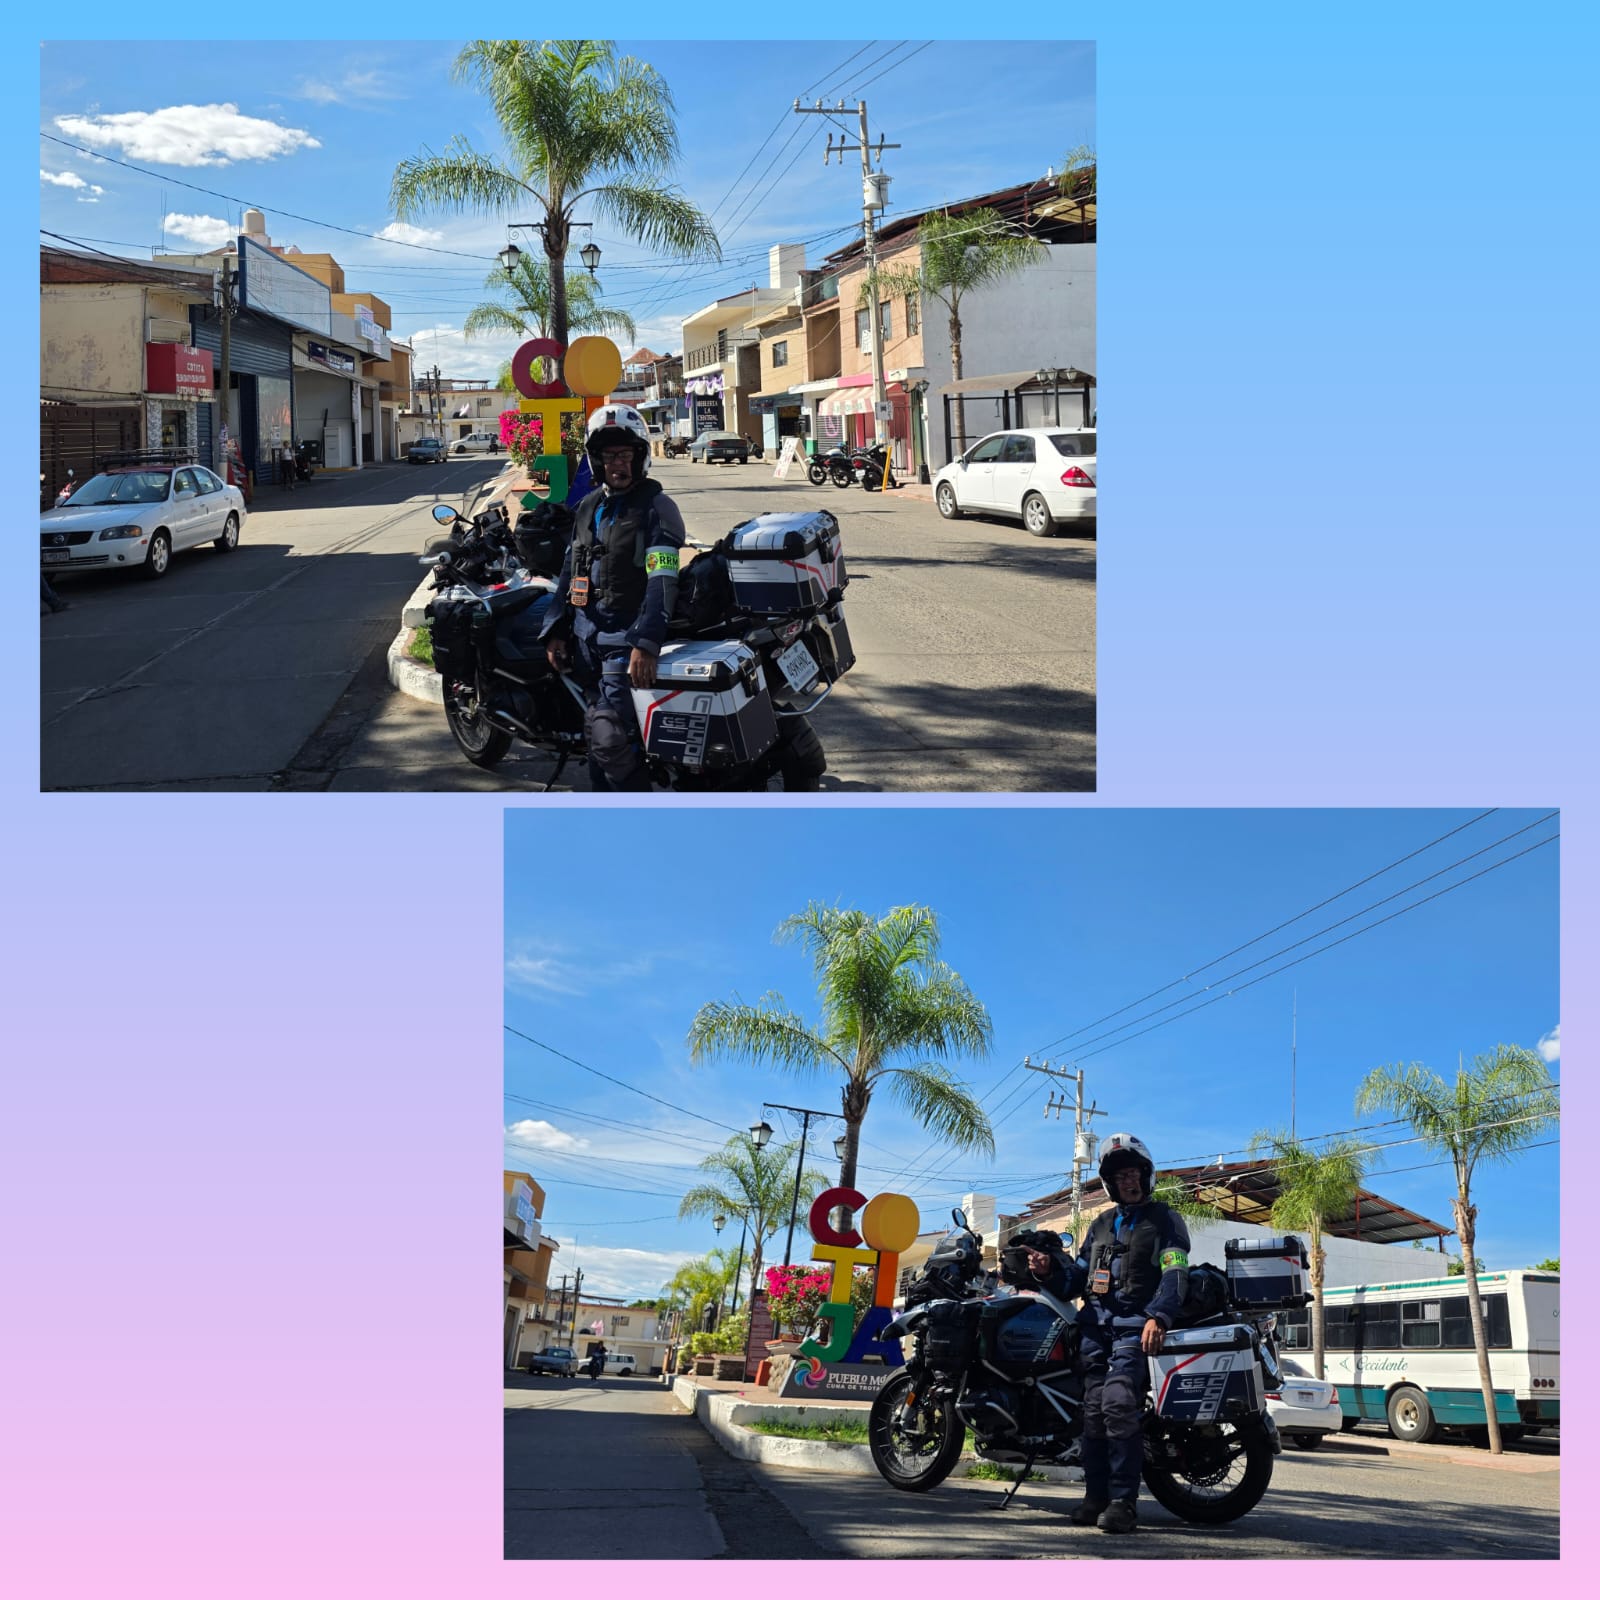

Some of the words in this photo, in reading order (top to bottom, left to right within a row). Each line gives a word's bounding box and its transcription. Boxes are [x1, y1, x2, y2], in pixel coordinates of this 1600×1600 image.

[662, 716, 687, 728] GS
[1356, 1355, 1408, 1371] Occidente
[1180, 1377, 1206, 1388] GS
